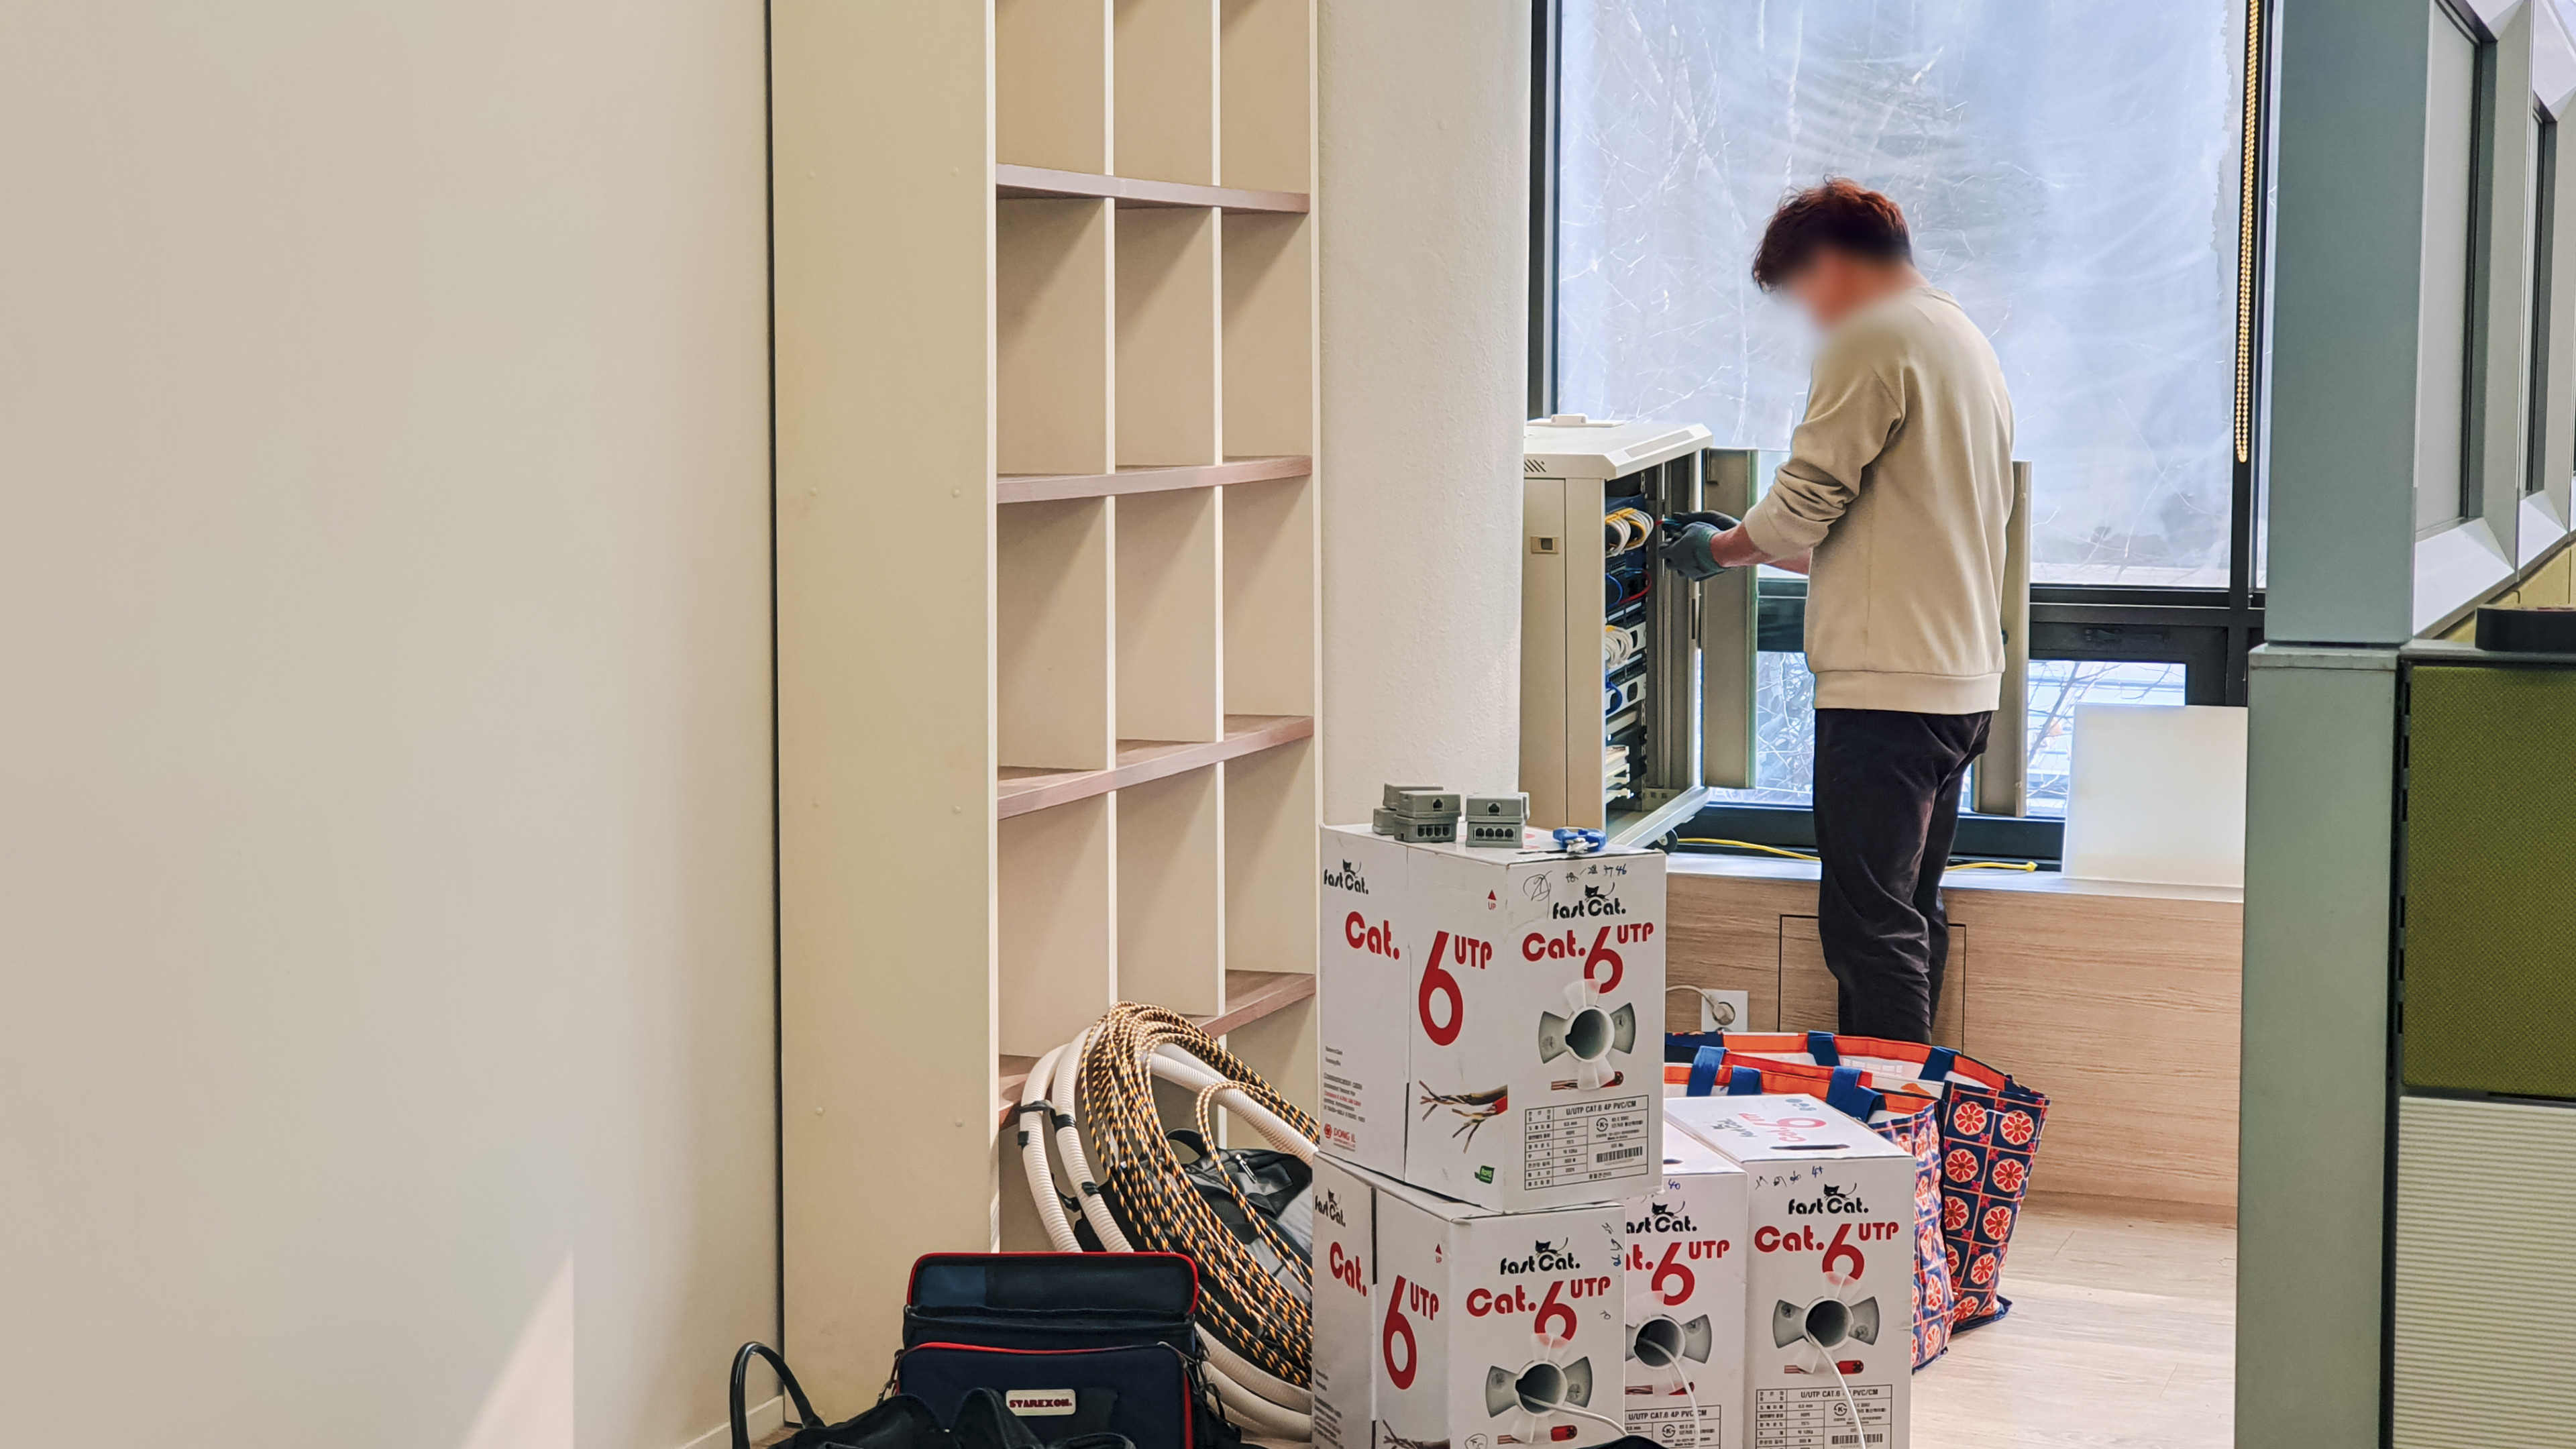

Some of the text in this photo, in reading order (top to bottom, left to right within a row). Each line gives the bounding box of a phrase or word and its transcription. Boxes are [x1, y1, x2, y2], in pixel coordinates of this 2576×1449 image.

[1488, 902, 1497, 910] UP
[1345, 911, 1400, 961] Cat.
[1617, 922, 1655, 945] UTP
[1418, 930, 1493, 1046] 6 UTP
[1566, 1108, 1584, 1116] U/UTP
[1334, 1128, 1350, 1141] DONG
[1626, 1216, 1652, 1234] ast
[1858, 1221, 1900, 1242] UTP
[1688, 1239, 1731, 1260] UTP
[1330, 1242, 1368, 1297] Cat.
[1570, 1276, 1612, 1299] UTP
[1383, 1275, 1440, 1390] 6 UTP
